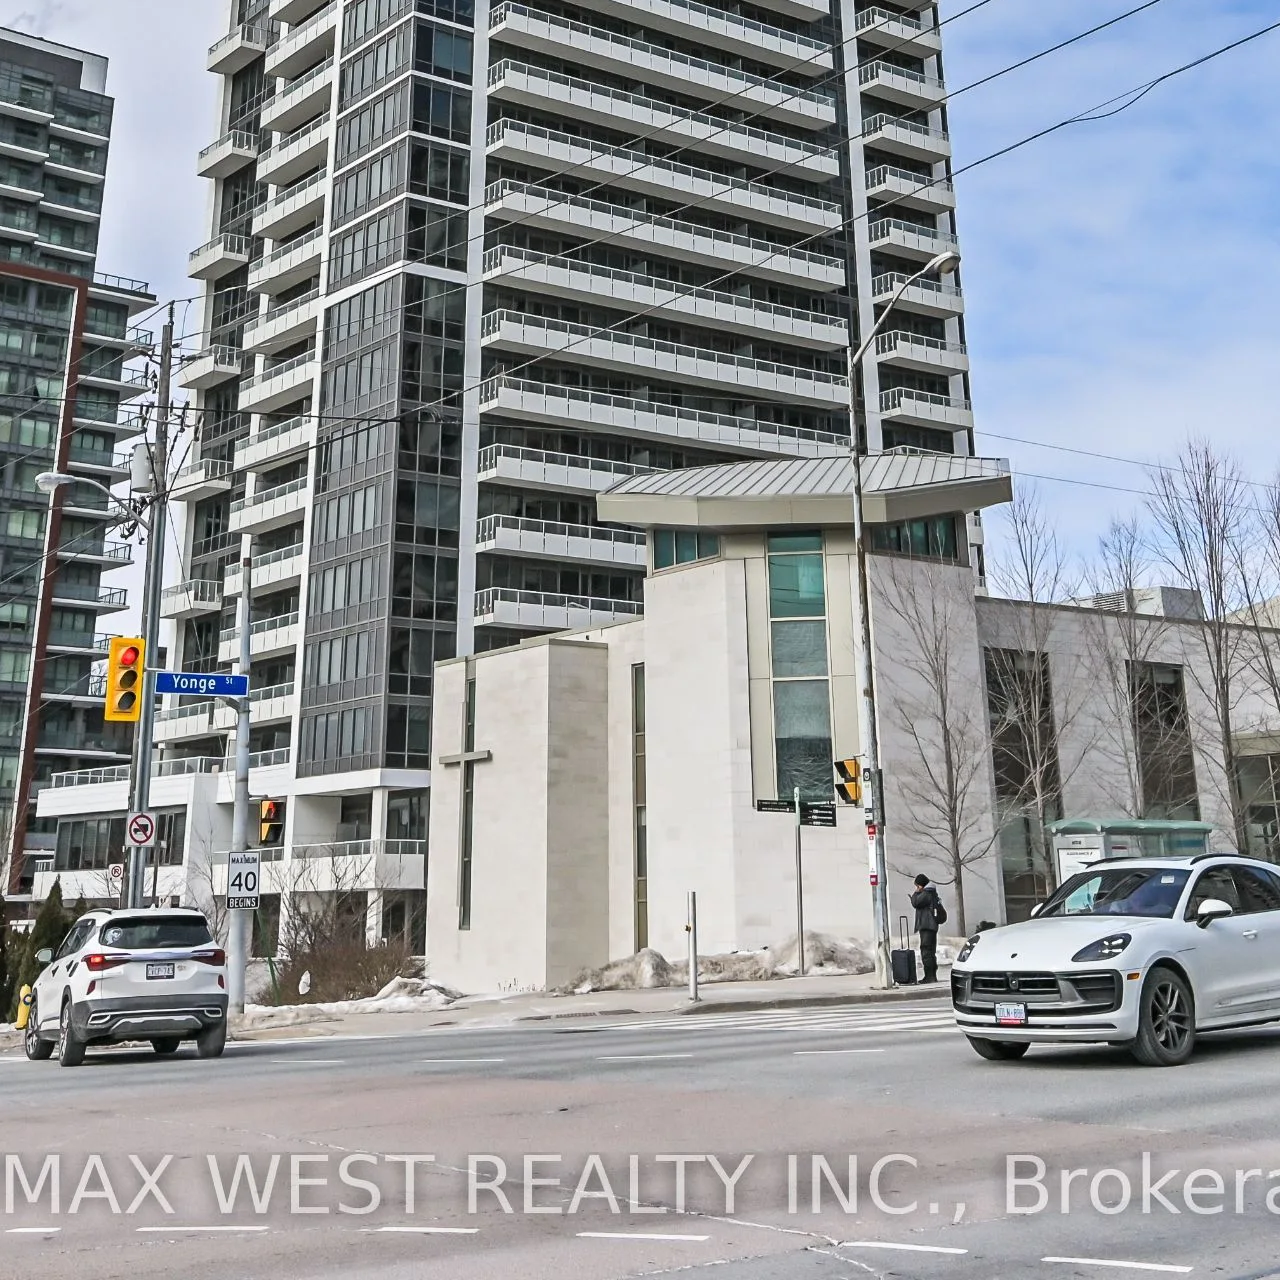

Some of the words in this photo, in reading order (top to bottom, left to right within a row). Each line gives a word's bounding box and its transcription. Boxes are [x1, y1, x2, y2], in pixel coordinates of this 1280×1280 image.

[173, 674, 216, 693] Yonge
[225, 676, 233, 685] St
[230, 871, 257, 892] 40
[229, 897, 256, 908] BEGINS
